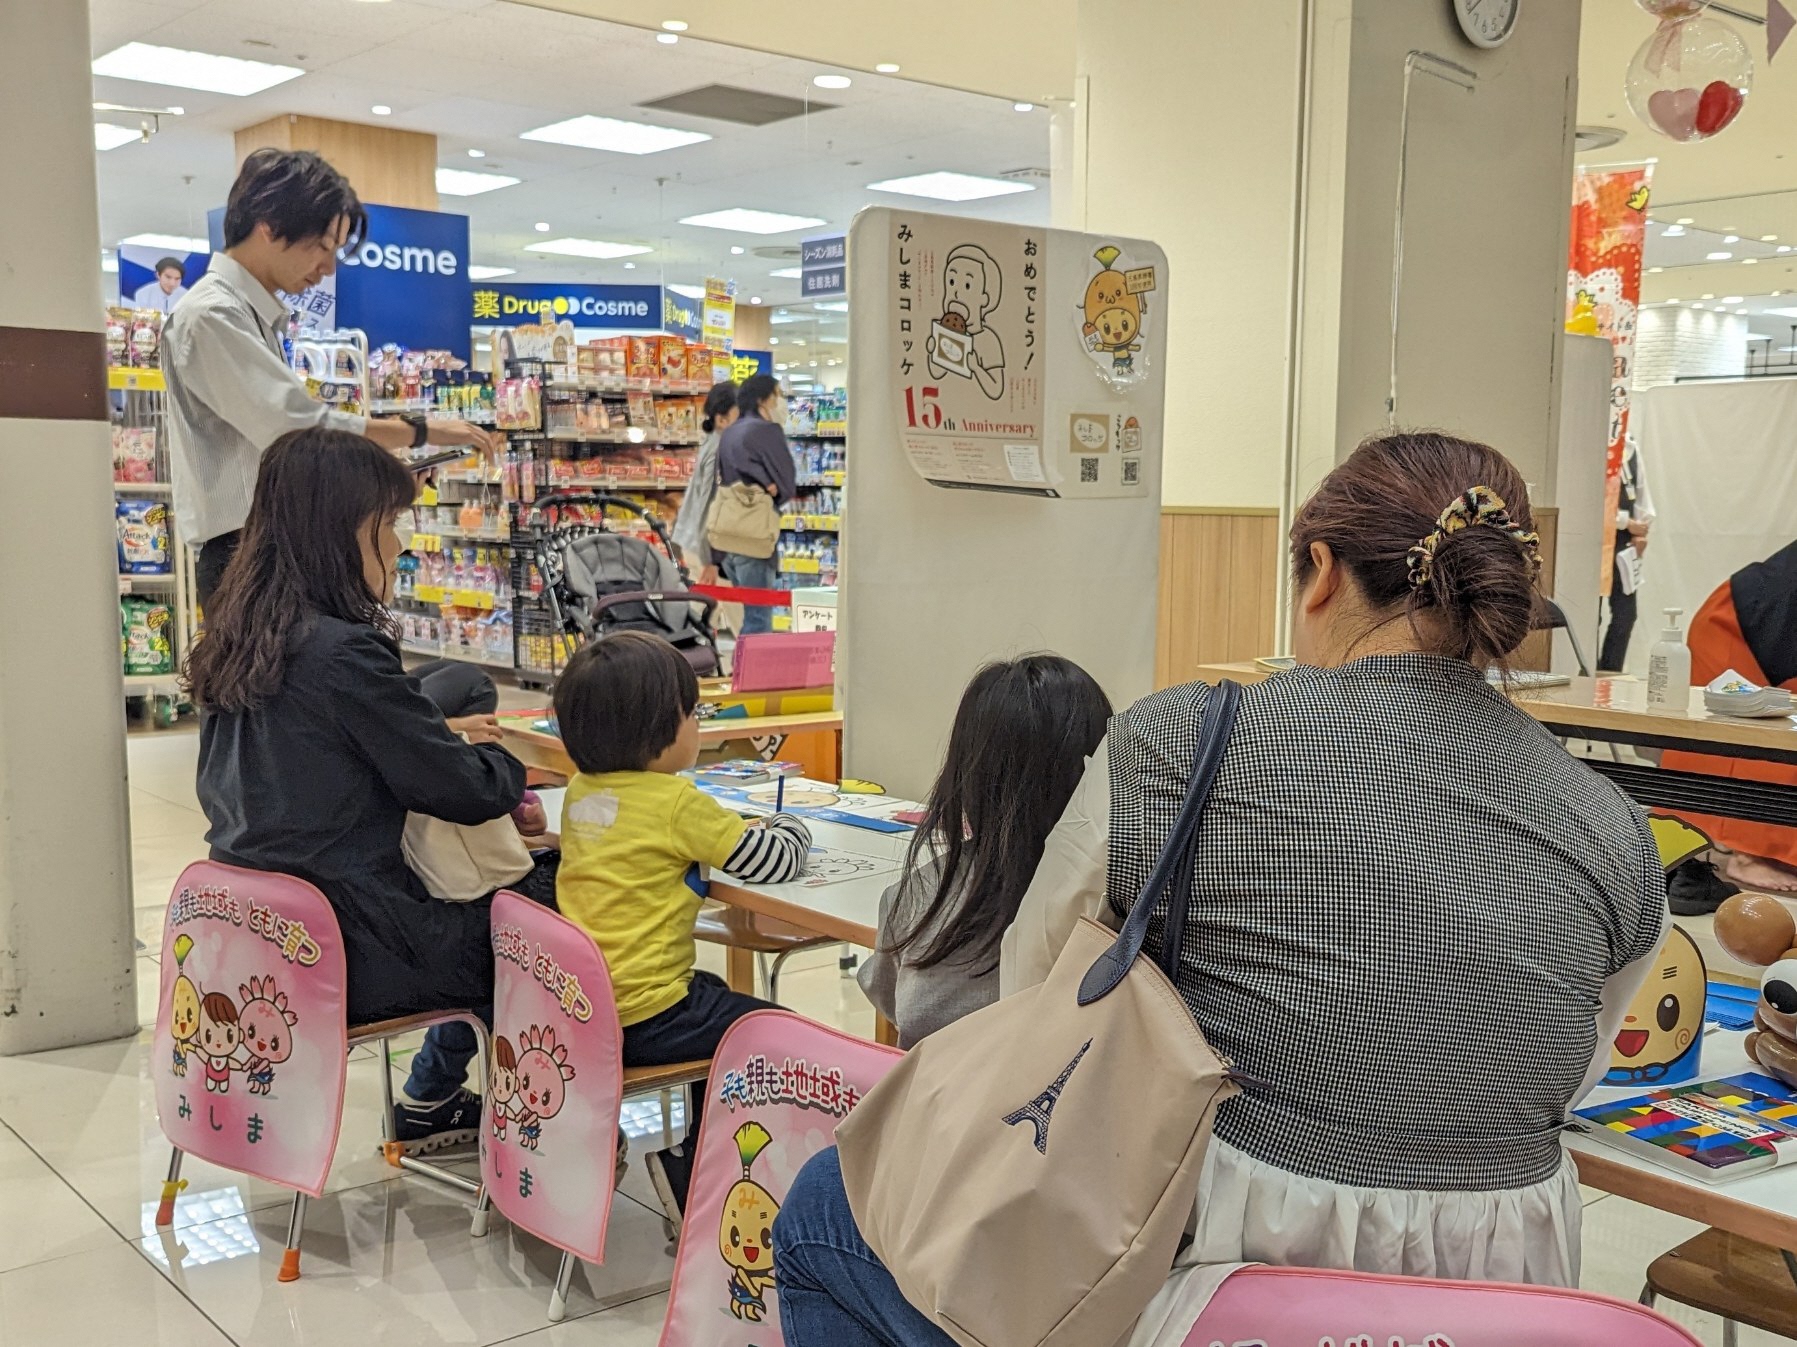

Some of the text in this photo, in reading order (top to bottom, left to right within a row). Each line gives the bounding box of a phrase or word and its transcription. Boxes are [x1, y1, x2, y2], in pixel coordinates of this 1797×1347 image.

[1473, 13, 1480, 26] 7
[1482, 20, 1487, 33] 6
[473, 290, 499, 318] 薬
[581, 296, 649, 317] Cosme
[897, 224, 914, 375] みしまコロッケ
[961, 419, 1037, 438] Anniversary
[802, 610, 833, 620] アンケート
[247, 897, 322, 966] ともに育つ
[535, 944, 592, 1019] ともに育つ
[178, 1094, 263, 1144] みしま
